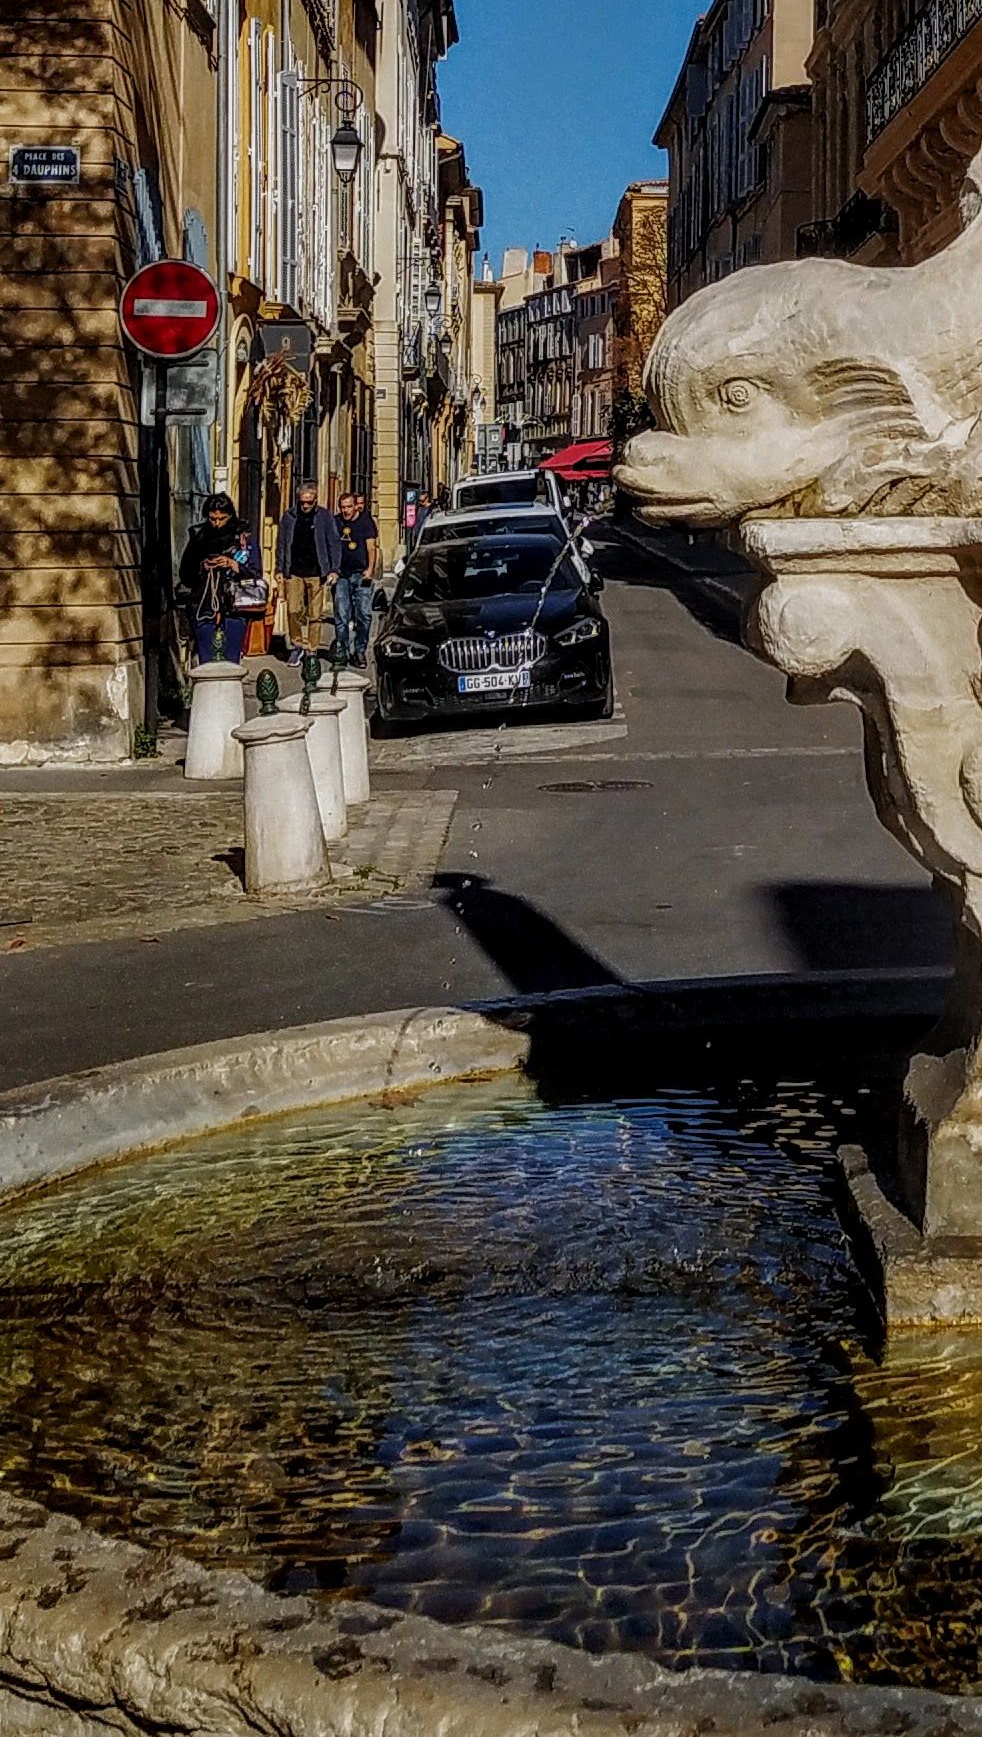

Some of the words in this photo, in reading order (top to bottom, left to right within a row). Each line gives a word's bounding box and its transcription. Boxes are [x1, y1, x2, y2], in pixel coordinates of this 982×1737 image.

[24, 153, 47, 161] PLACE
[52, 153, 65, 161] DES
[13, 165, 18, 175] 4
[23, 164, 76, 176] DAUPHINS
